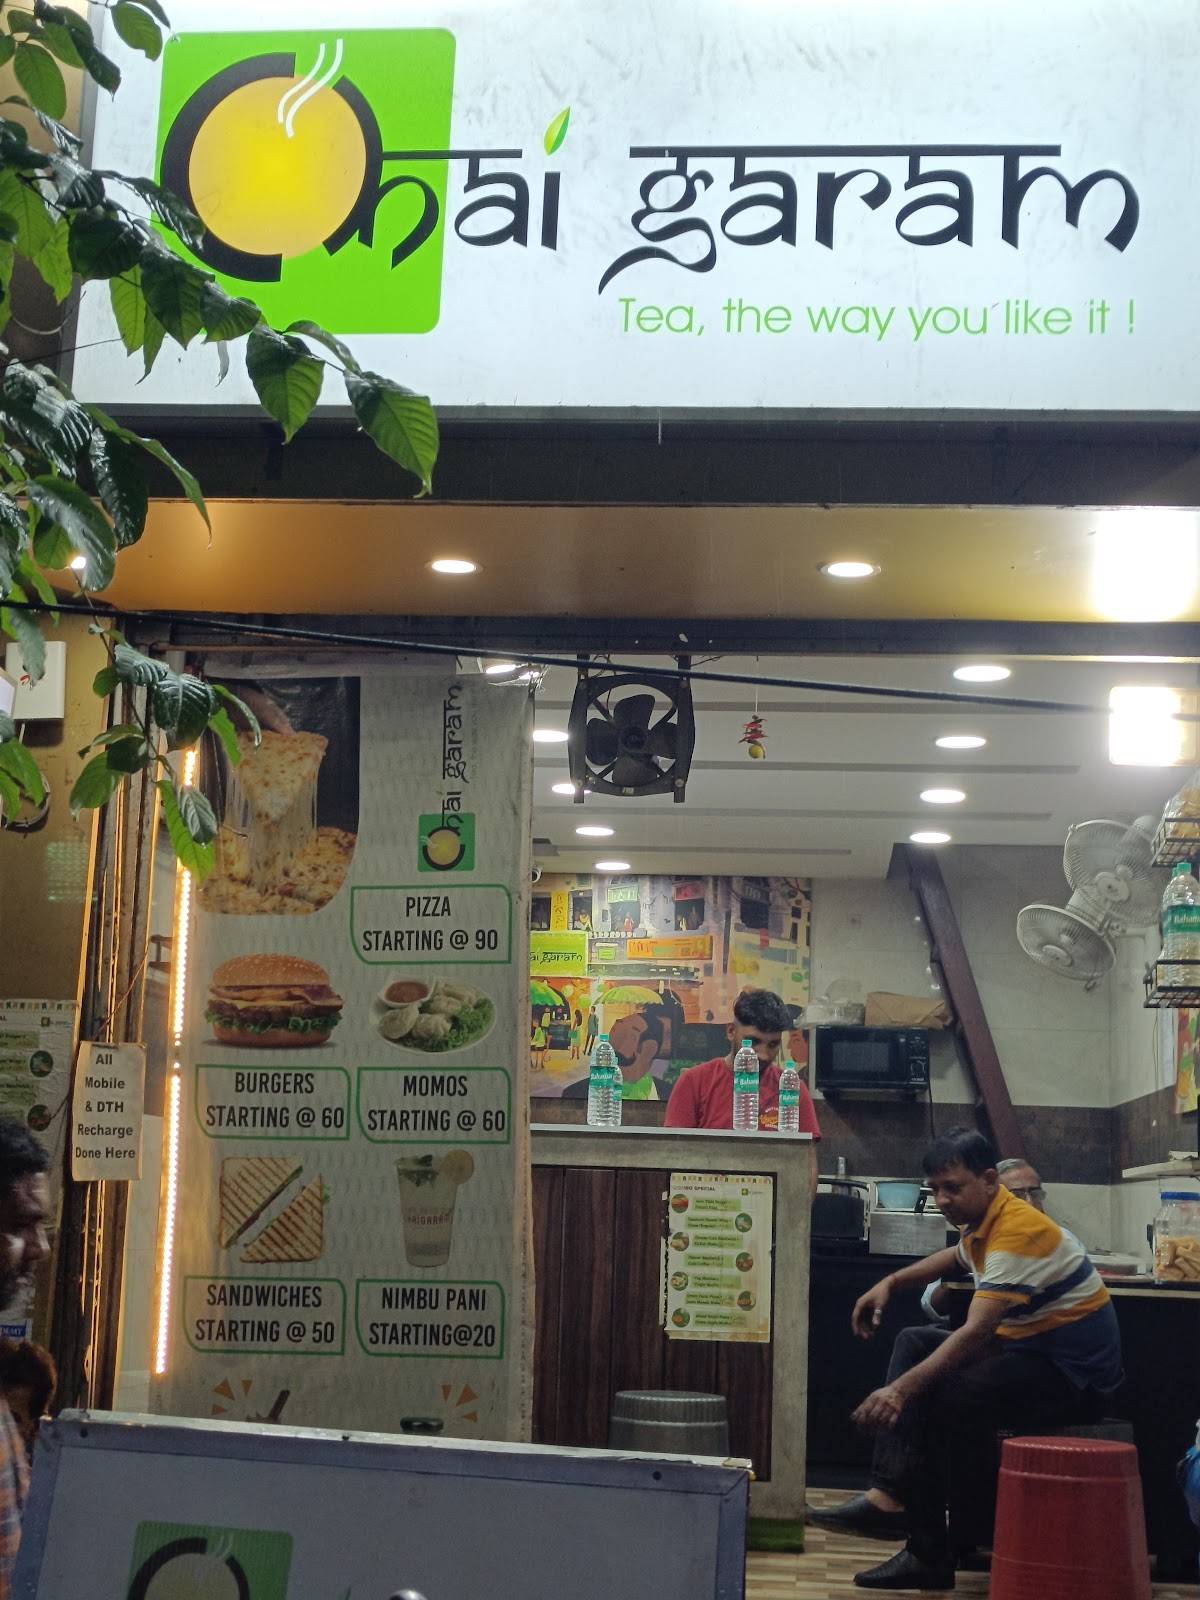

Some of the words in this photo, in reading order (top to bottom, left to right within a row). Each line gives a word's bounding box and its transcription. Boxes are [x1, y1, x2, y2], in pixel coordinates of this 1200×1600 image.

[599, 144, 1140, 295] garam
[618, 297, 704, 335] Tea,
[721, 298, 792, 333] the
[808, 305, 893, 342] way
[907, 305, 989, 341] you
[1004, 298, 1073, 333] like
[1089, 299, 1108, 333] it
[442, 682, 470, 783] garam
[405, 895, 451, 918] PIZZA
[362, 930, 444, 952] STARTING
[449, 930, 469, 950] @
[475, 929, 498, 951] 90
[95, 1053, 113, 1065] All
[85, 1076, 126, 1090] Mobile
[234, 1072, 315, 1094] BURGERS
[403, 1075, 468, 1097] MOMOS
[85, 1101, 93, 1113] &
[97, 1101, 124, 1113] DTH
[206, 1106, 290, 1129] STARTING
[295, 1108, 316, 1127] @
[321, 1107, 345, 1128] 60
[77, 1123, 134, 1139] Recharge
[367, 1109, 451, 1132] STARTING
[456, 1111, 477, 1131] @
[482, 1110, 506, 1132] 60
[75, 1146, 102, 1159] Done
[105, 1147, 136, 1159] Here
[207, 1284, 322, 1308] SANDWICHES
[381, 1288, 440, 1310] NIMBU
[446, 1288, 486, 1311] PANI
[195, 1320, 281, 1343] STARTING
[286, 1322, 307, 1343] @
[311, 1322, 335, 1343] 50
[369, 1323, 496, 1347] STARTING@20
